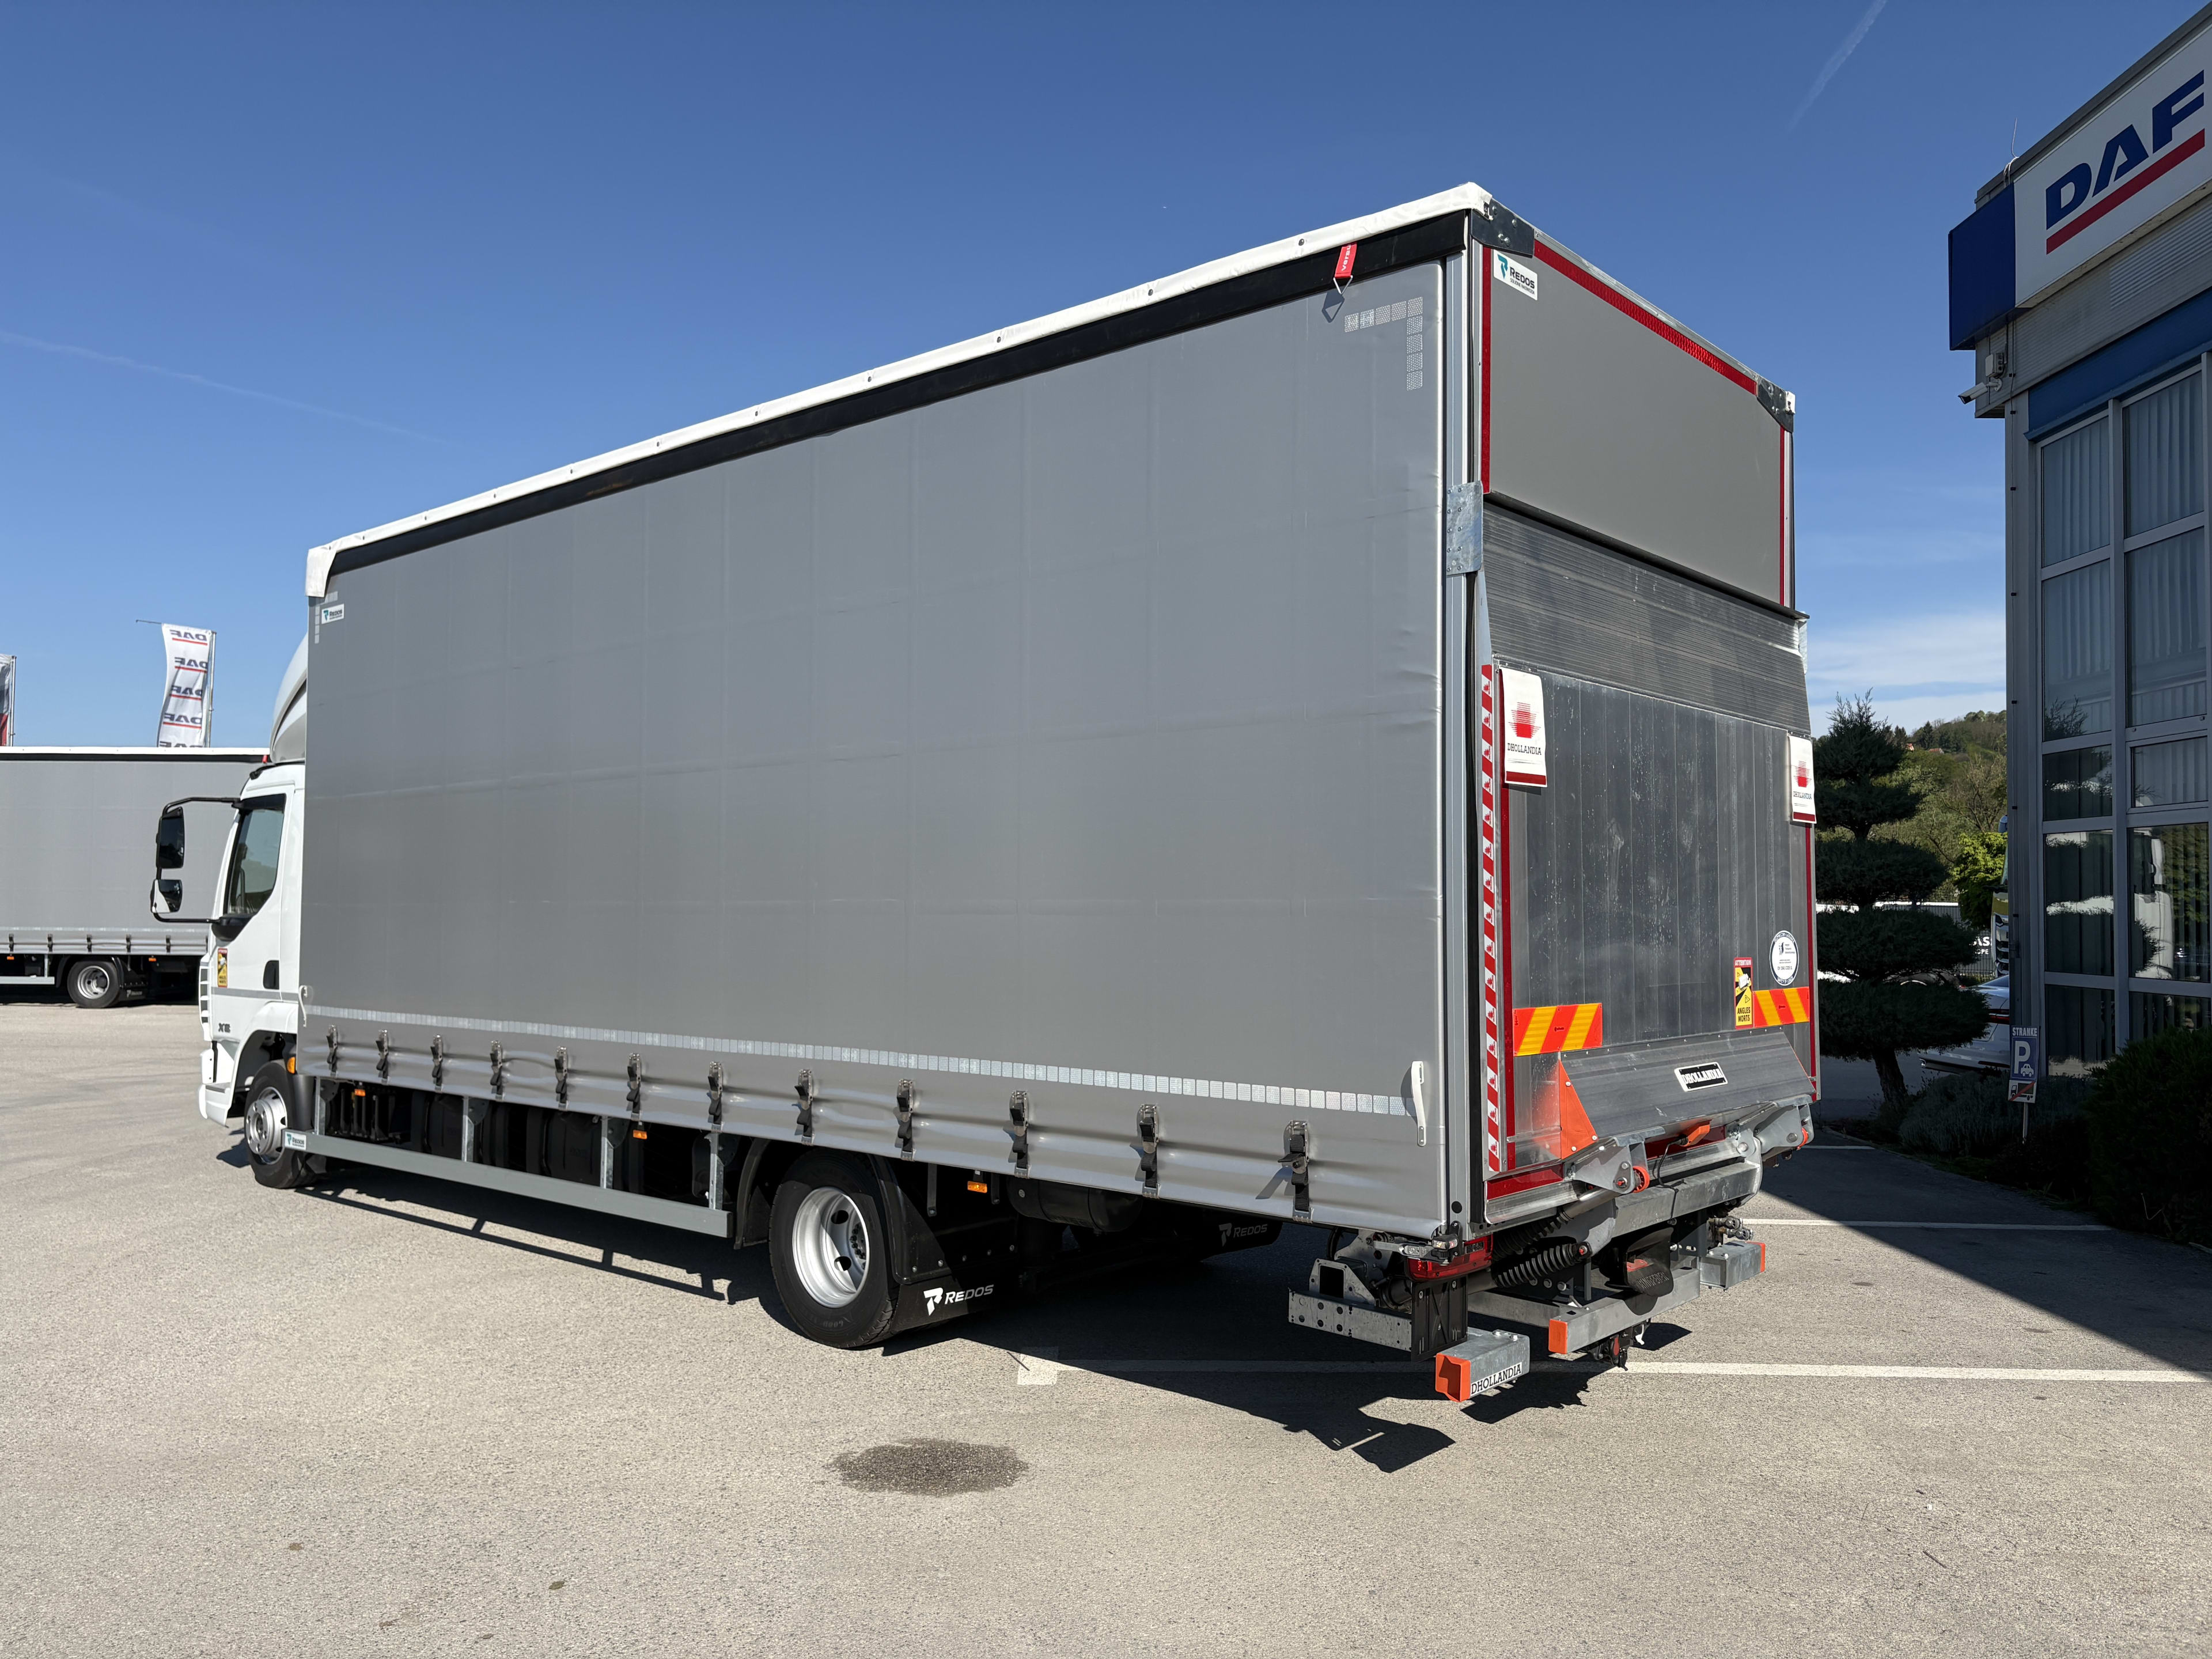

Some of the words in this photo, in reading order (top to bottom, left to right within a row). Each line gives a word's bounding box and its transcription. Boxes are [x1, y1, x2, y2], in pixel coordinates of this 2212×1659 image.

[2046, 70, 2205, 230] DAF
[1510, 267, 1535, 289] REDOS
[1508, 743, 1541, 755] DHOLLANDIA
[2012, 1028, 2037, 1036] STRANKE
[2014, 1040, 2031, 1074] P
[1681, 1069, 1724, 1084] DHOLLANDIA
[1233, 1224, 1268, 1238] REDOS
[945, 1285, 994, 1305] REDOS
[1471, 1364, 1521, 1394] DHOLLANDIA
